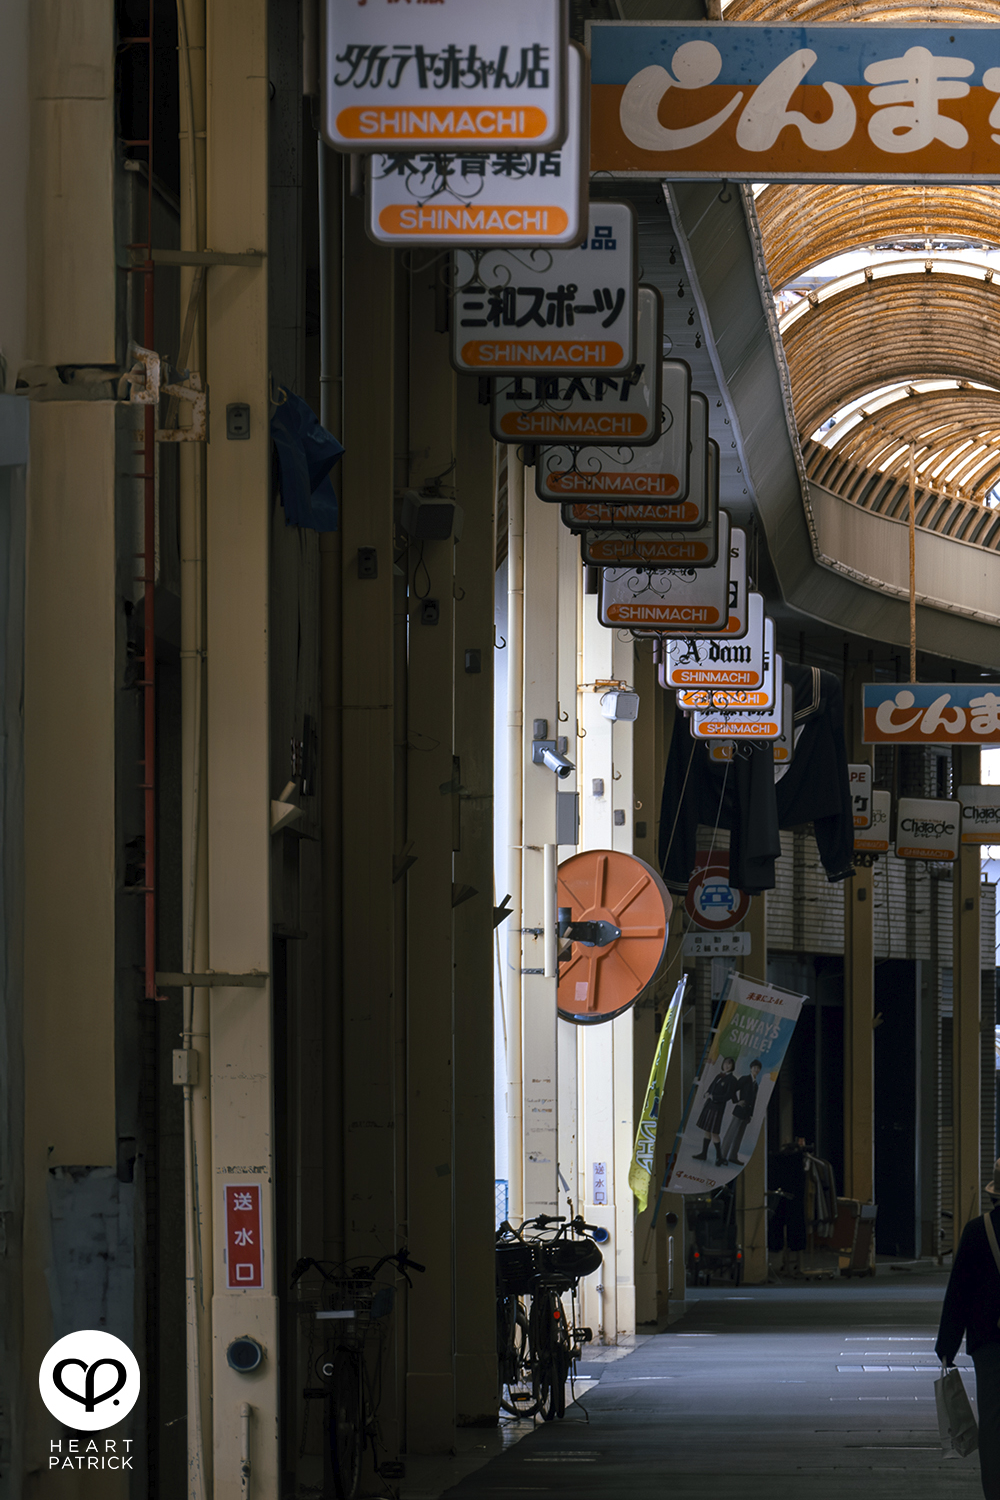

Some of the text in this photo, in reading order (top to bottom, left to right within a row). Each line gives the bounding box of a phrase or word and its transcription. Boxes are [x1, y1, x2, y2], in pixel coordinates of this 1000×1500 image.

[358, 111, 525, 134] SHINMACHI
[399, 209, 548, 231] SHINMACHI
[460, 284, 625, 328] 三和スポーツ
[479, 344, 606, 362] SHINMACHI
[516, 416, 632, 433] SHINMACHI
[560, 476, 666, 492] SHINMACHI
[586, 503, 685, 519] SHINMACHI
[602, 544, 695, 557] SHINMACHI
[618, 606, 707, 622] SHINMACHI
[681, 671, 750, 683] SHINMACHI
[691, 693, 760, 704] SHINMACHI
[707, 723, 770, 734] SHINMACHI
[901, 818, 956, 835] Charade
[731, 1013, 780, 1039] ALWAYS
[729, 1029, 773, 1053] SMILE!
[595, 1166, 605, 1201] 送水口
[233, 1192, 254, 1281] 送水口
